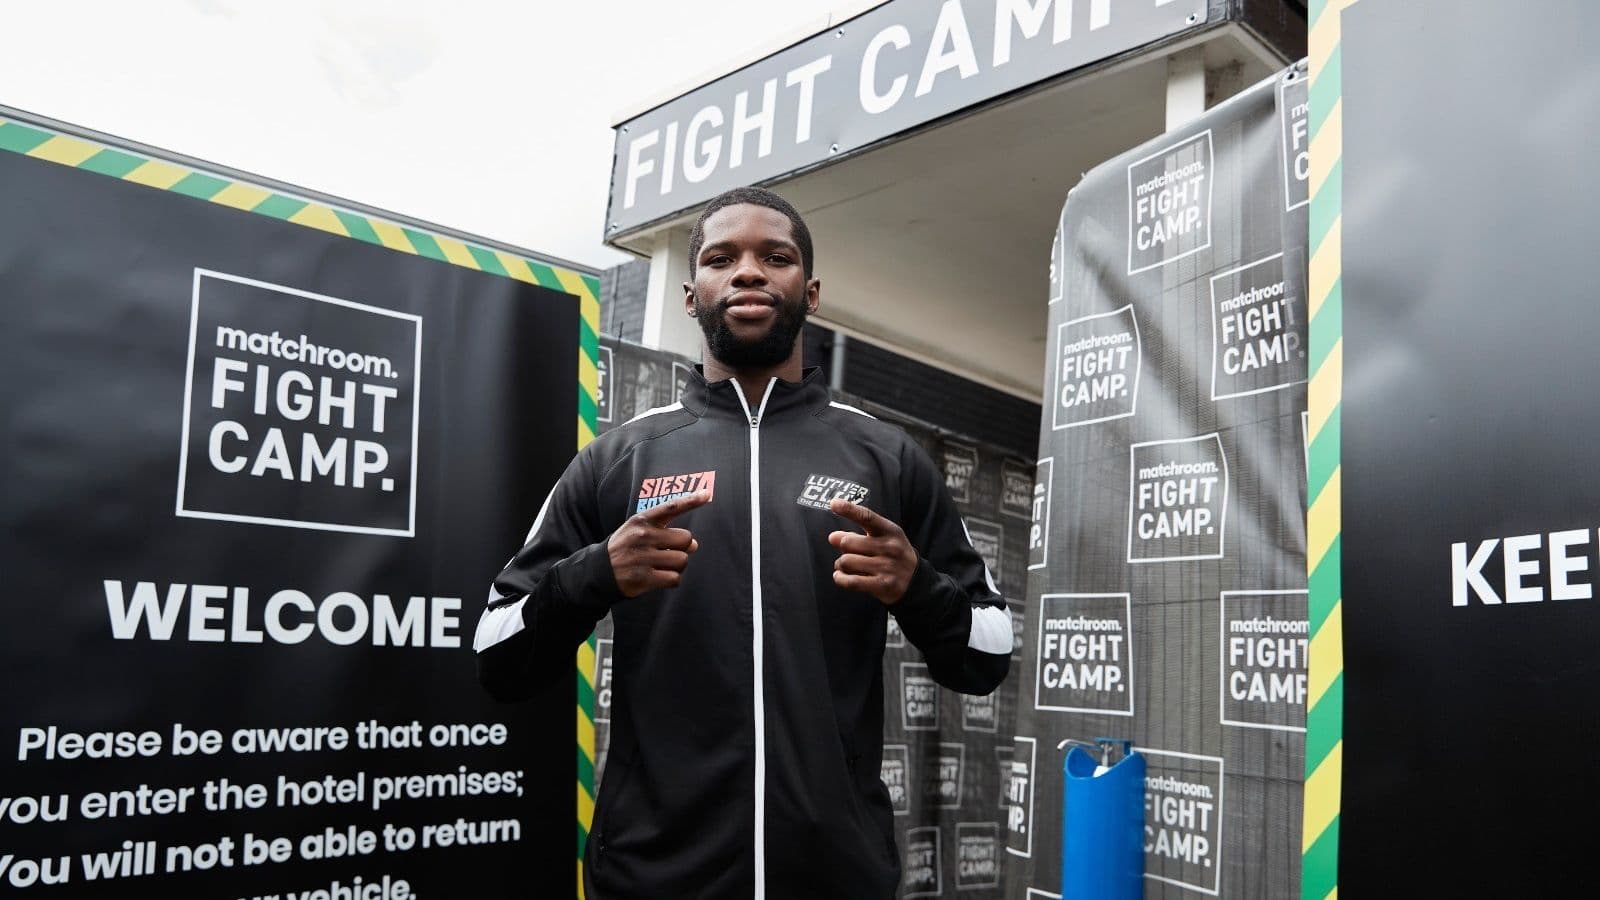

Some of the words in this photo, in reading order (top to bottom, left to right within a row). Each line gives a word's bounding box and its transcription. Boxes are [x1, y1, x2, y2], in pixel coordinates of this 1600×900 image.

[624, 54, 832, 209] FIGHT
[859, 0, 1111, 114] CAM
[1137, 161, 1204, 196] matchroom.
[1137, 174, 1204, 223] FIGHT
[1137, 206, 1202, 250] CAMP.
[1222, 297, 1297, 345] FIGHT
[216, 326, 398, 378] matchroom.
[1064, 332, 1133, 355] matchroom.
[1223, 332, 1304, 375] CAMP.
[1063, 346, 1132, 381] FIGHT
[211, 357, 398, 433] FIGHT
[1061, 374, 1128, 408] CAMP.
[208, 420, 395, 492] CAMP.
[1139, 461, 1219, 480] matchroom.
[639, 471, 716, 501] SIESTA
[808, 475, 869, 499] LUTHER
[1139, 477, 1218, 510] FIGHT
[1138, 508, 1214, 539] CAMP.
[1452, 527, 1600, 607] KEE
[103, 580, 462, 648] WELCOME
[1045, 615, 1122, 631] matchroom.
[1044, 634, 1122, 661] FIGHT
[1230, 637, 1308, 668] FIGHT
[1043, 662, 1125, 692] CAMP.
[18, 726, 162, 761] Please
[172, 723, 223, 755] be
[232, 727, 349, 754] aware
[356, 720, 423, 749] that
[429, 723, 508, 747] once
[80, 784, 195, 819] enter
[203, 778, 268, 811] the
[277, 772, 365, 807] hotel
[372, 765, 524, 810] premises;
[82, 840, 157, 881] will
[166, 836, 235, 873] not
[243, 833, 293, 866] be
[300, 825, 377, 860] able
[382, 823, 416, 852] to
[422, 818, 521, 848] return
